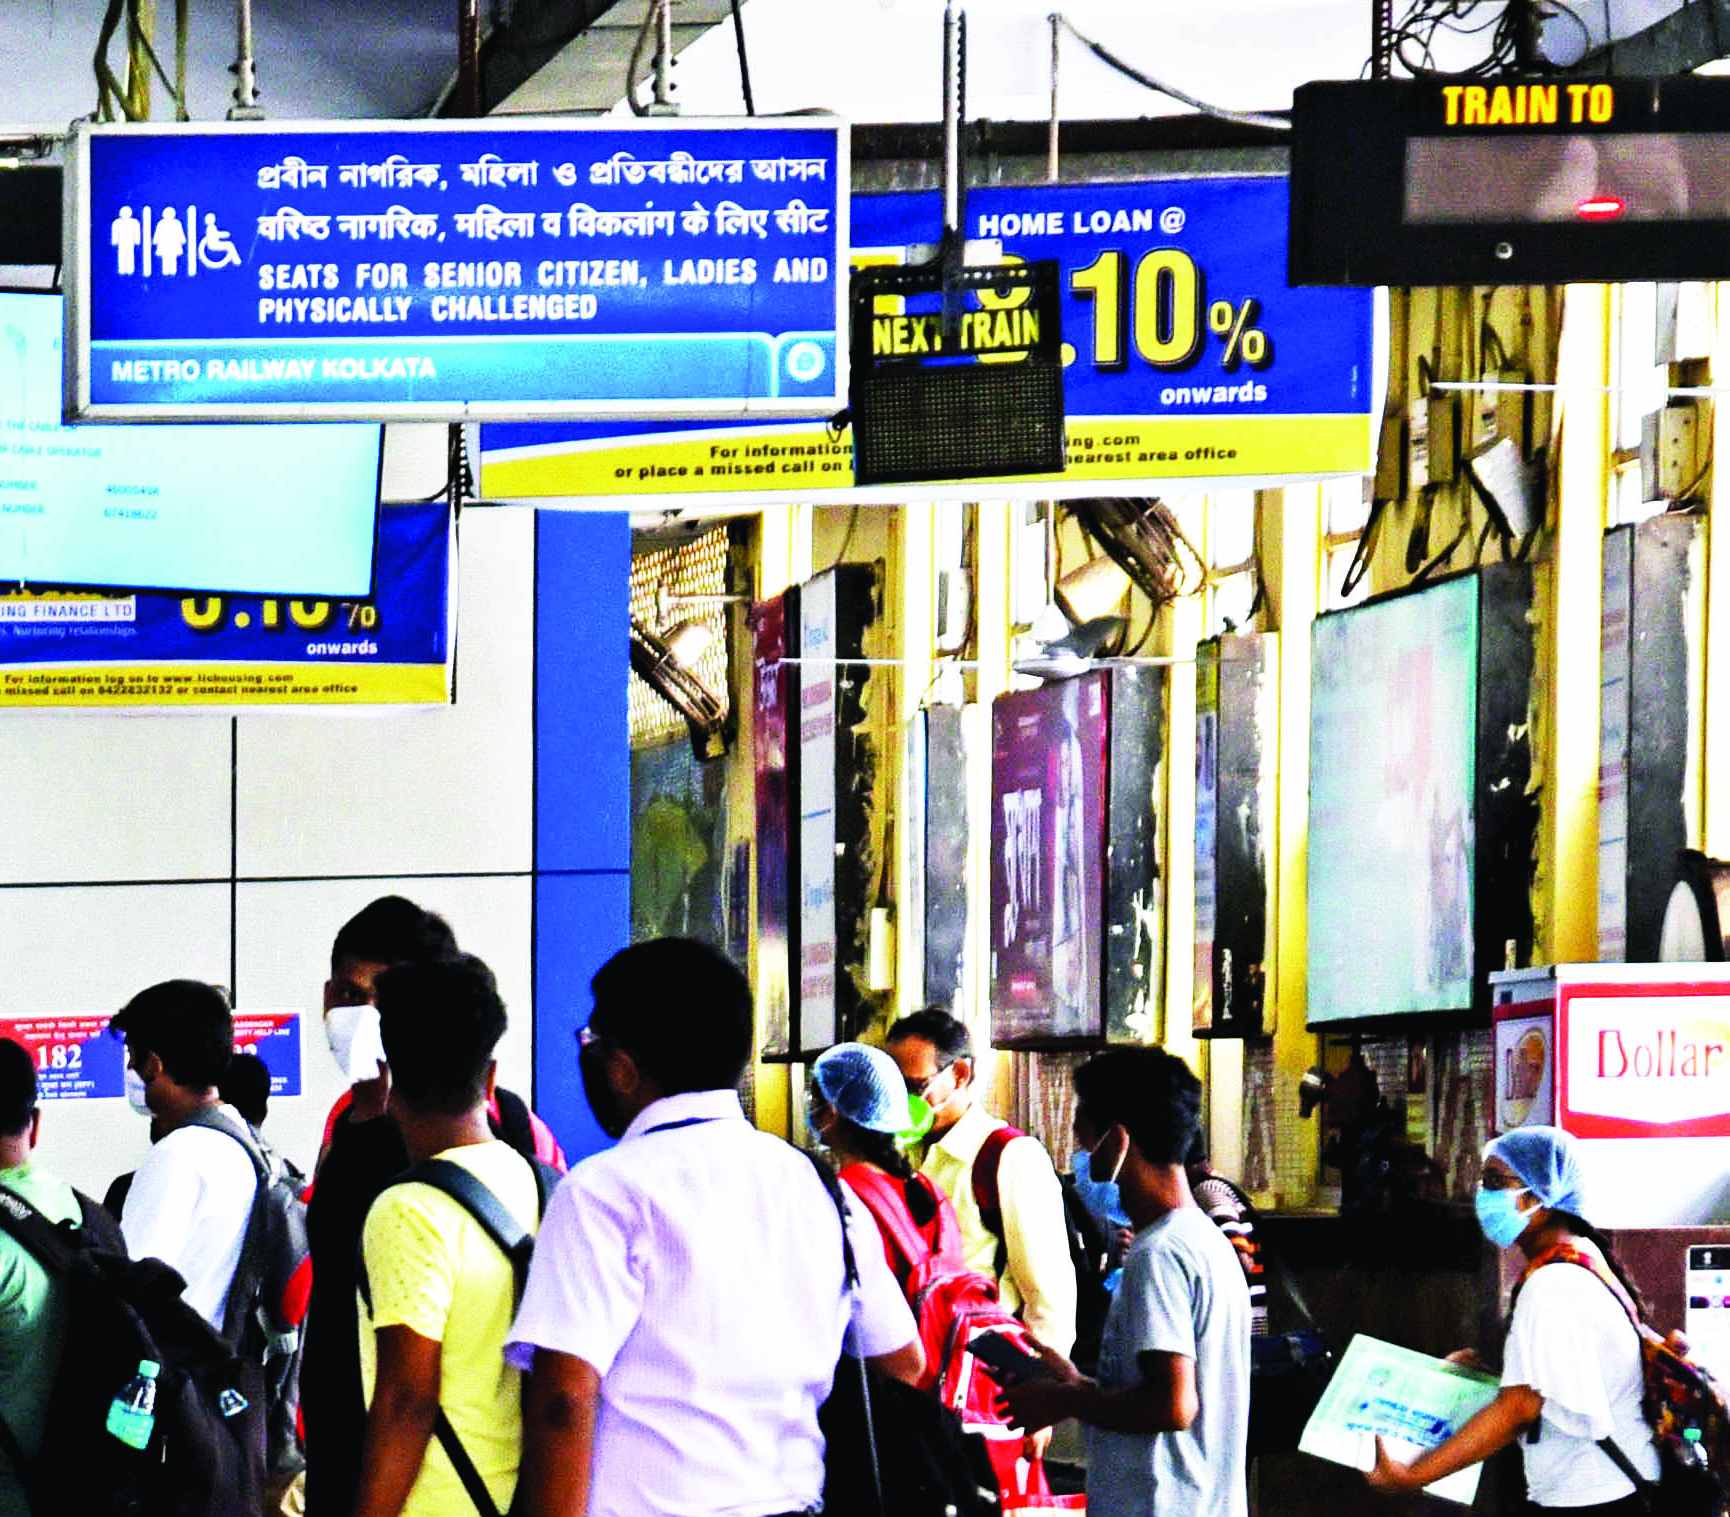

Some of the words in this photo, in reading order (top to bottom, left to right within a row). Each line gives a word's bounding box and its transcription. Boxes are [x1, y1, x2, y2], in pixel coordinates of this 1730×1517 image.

[1442, 84, 1558, 126] TRAIN
[1567, 83, 1614, 124] TO
[339, 154, 447, 191] নাগরিক,
[459, 153, 539, 188] মহিলা
[553, 162, 577, 186] ও
[749, 157, 828, 183] আসন
[257, 206, 331, 240] वरिष्ठ
[336, 204, 446, 243] नागरिक,
[454, 203, 536, 240] महिला
[541, 212, 562, 237] व
[568, 202, 676, 237] विकलांग
[681, 201, 710, 236] के
[714, 200, 770, 240] लिए
[774, 199, 829, 234] सीट
[979, 211, 1064, 237] HOME
[1074, 209, 1152, 234] LOAN
[1160, 207, 1187, 234] @
[258, 263, 339, 290] SEATS
[355, 263, 408, 289] FOR
[423, 261, 522, 289] SENIOR
[538, 260, 647, 288] CITIZEN,
[663, 257, 757, 286] LADIES
[773, 257, 828, 283] AND
[258, 295, 412, 323] PHYSICALLY
[431, 293, 597, 322] CHALLENGED
[873, 317, 942, 355] NEXT
[960, 309, 1039, 350] TRAIN
[112, 360, 199, 382] METRO
[208, 358, 316, 380] RAILWAY
[322, 357, 436, 378] KOLKATA
[1160, 380, 1268, 405] onwards
[710, 445, 738, 458] For
[745, 443, 854, 457] information
[1138, 450, 1178, 462] area
[1184, 447, 1237, 460] office
[615, 466, 633, 478] or
[639, 464, 687, 480] place
[694, 466, 704, 477] a
[711, 462, 775, 476] missed
[782, 461, 814, 474] call
[822, 461, 842, 472] on
[34, 604, 96, 617] FINANCE
[104, 604, 132, 617] LTD
[306, 640, 378, 655] onwards
[37, 1043, 82, 1069] 182
[1596, 1029, 1723, 1078] Dollar
